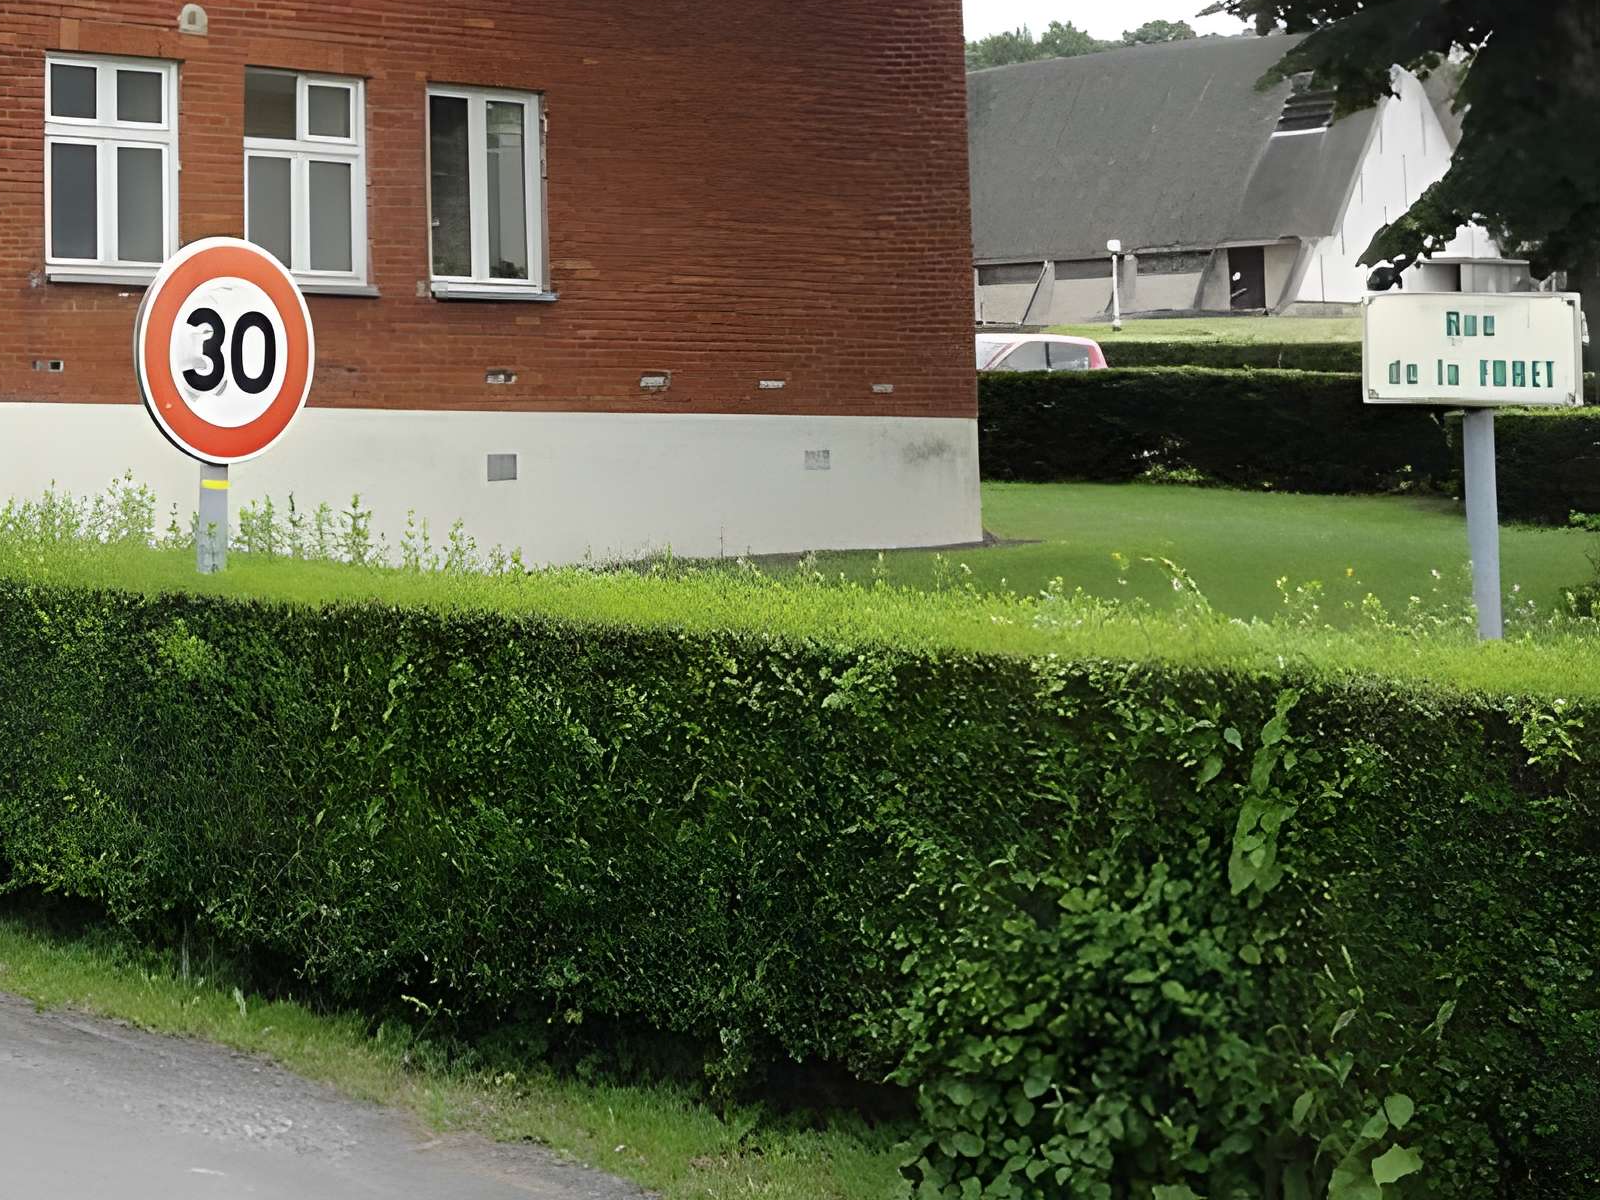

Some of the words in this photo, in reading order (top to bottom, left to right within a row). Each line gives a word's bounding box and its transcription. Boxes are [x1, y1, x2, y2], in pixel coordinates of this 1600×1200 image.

[1446, 311, 1496, 337] Rue
[183, 307, 277, 395] 30
[1389, 360, 1419, 385] de
